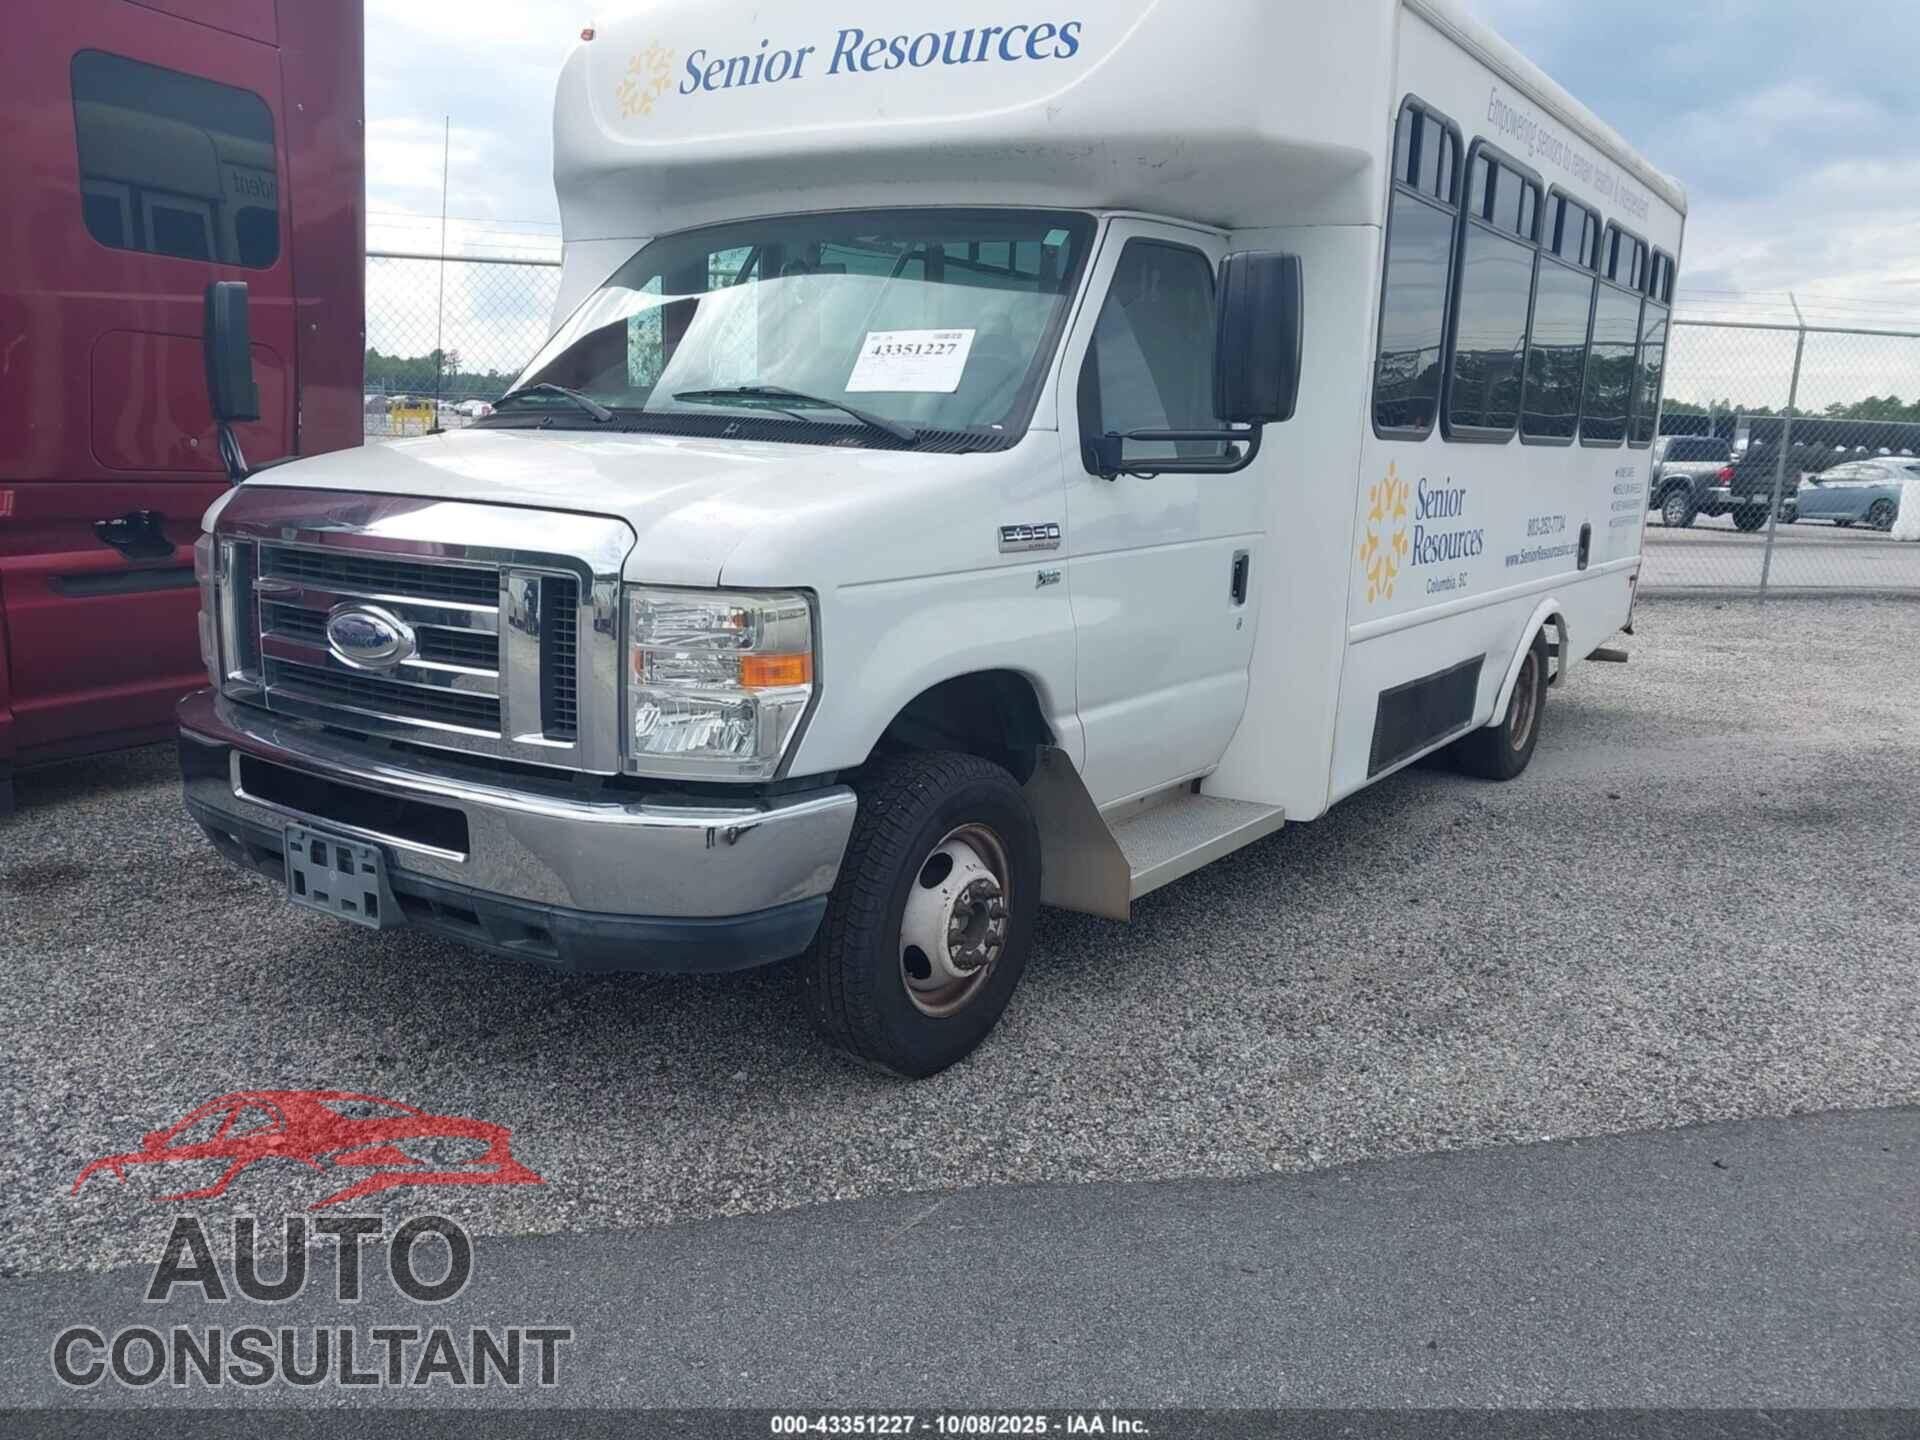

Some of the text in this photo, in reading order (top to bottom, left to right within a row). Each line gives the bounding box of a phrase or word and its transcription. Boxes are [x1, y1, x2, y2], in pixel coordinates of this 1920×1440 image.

[679, 20, 1082, 95] Senior Resources
[1487, 86, 1537, 158] Empowering
[871, 343, 958, 356] 43351227
[1415, 475, 1467, 521] Senior
[1410, 524, 1485, 567] Resources
[1458, 571, 1468, 589] SC
